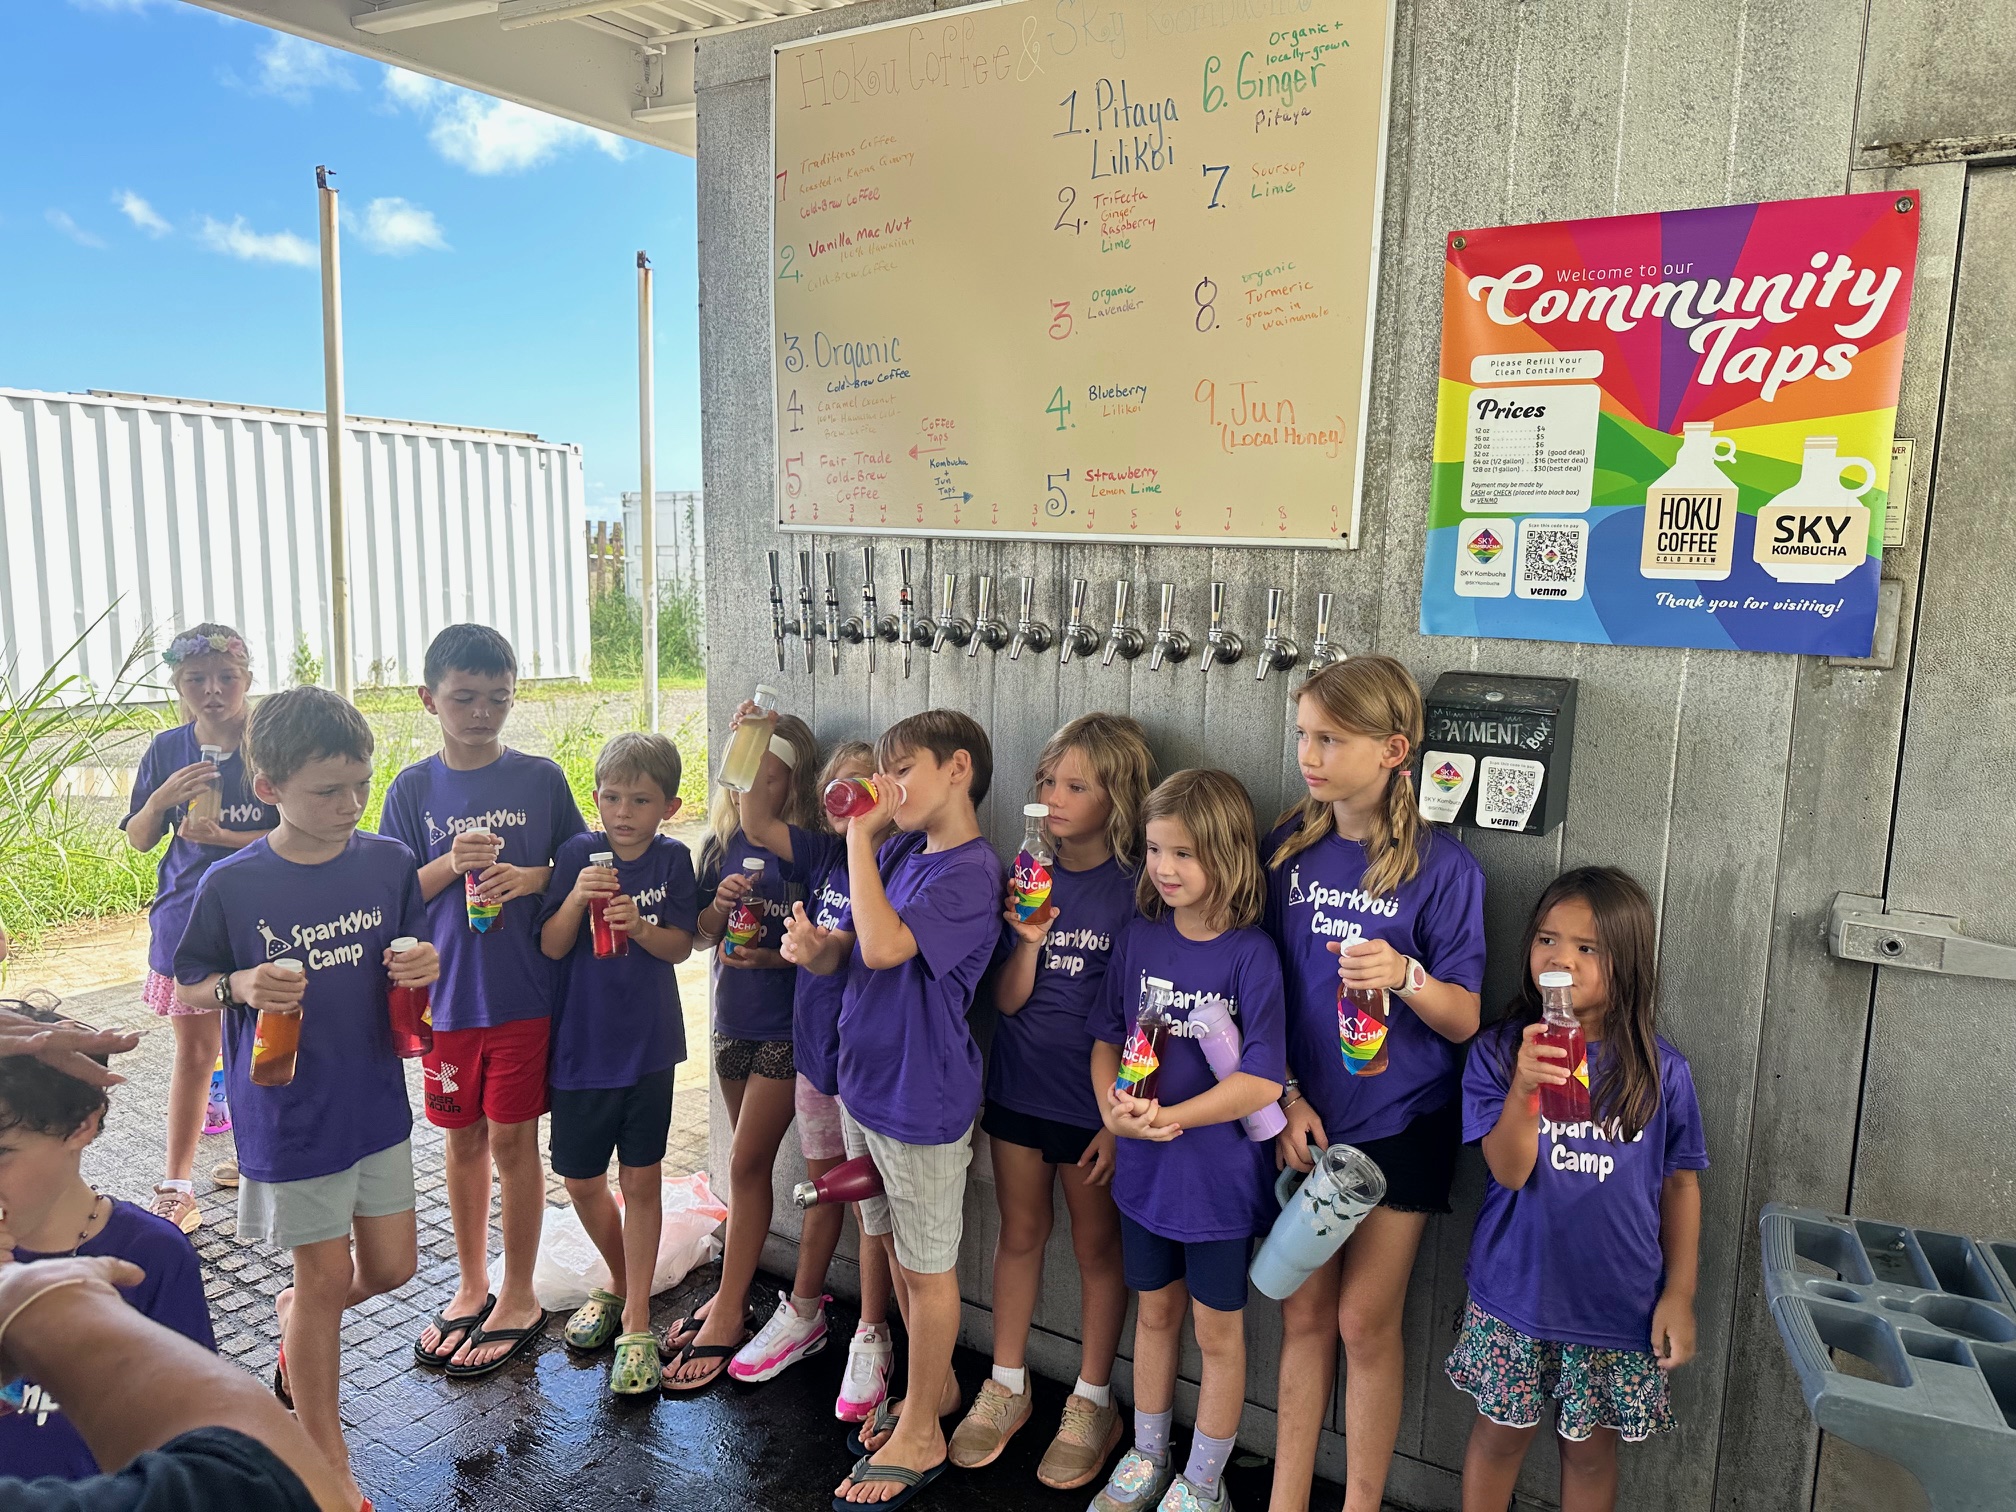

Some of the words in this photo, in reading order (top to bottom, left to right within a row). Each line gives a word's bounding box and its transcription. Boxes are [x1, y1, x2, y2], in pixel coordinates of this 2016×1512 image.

[796, 42, 899, 110] Hoku
[908, 17, 1011, 90] Coffee
[1017, 16, 1045, 82] &
[1236, 51, 1326, 108] Ginger
[1095, 78, 1179, 152] Pitaya
[1091, 136, 1174, 179] Lilikoi
[846, 187, 880, 205] Coffee
[1251, 184, 1295, 199] Lime
[1100, 204, 1136, 225] Ginger
[1100, 216, 1156, 236] Raspberry
[809, 232, 852, 258] Vanilla
[857, 224, 880, 241] Mac
[885, 217, 912, 236] Nut
[1102, 237, 1132, 253] Lime
[1556, 264, 1634, 283] Welcome
[1639, 262, 1658, 278] to
[1663, 260, 1695, 276] our
[1245, 280, 1314, 304] Turmeric
[1467, 250, 1902, 339] Community
[1088, 299, 1144, 320] Lavender
[815, 331, 901, 386] Organic
[1526, 358, 1555, 366] Refill
[1688, 316, 1860, 403] Taps
[877, 369, 910, 382] Coffee
[1525, 366, 1576, 375] Container
[1088, 384, 1147, 404] Blueberry
[1229, 380, 1296, 426] Jun
[1102, 401, 1141, 418] Lilikoi
[1476, 399, 1546, 420] Prices
[921, 417, 955, 432] Coffee
[1537, 425, 1546, 433] $4
[927, 433, 948, 446] Taps
[819, 454, 846, 468] Fair
[854, 451, 892, 465] Trade
[1547, 449, 1567, 457] (good
[1568, 449, 1586, 457] deal)
[929, 458, 968, 469] Kombucha
[1565, 465, 1582, 473] deal)
[826, 472, 888, 485] Cold-Brew
[934, 477, 951, 486] Jun
[1084, 466, 1159, 483] Strawberry
[836, 488, 879, 504] Coffee
[937, 486, 956, 496] Taps
[1091, 485, 1126, 498] Lemon
[1130, 482, 1162, 495] Lime
[1659, 497, 1722, 531] HOKU
[1773, 515, 1851, 543] SKY
[1657, 532, 1718, 553] COFFEE
[1772, 545, 1847, 556] KOMBUCHA
[1530, 587, 1567, 596] venmo
[1656, 592, 1704, 608] Thank
[1707, 598, 1738, 613] you
[1743, 597, 1768, 610] for
[1773, 598, 1844, 618] visiting!
[1437, 719, 1523, 745] PAYMENT
[1526, 722, 1550, 750] BOX
[1491, 818, 1518, 827] venm
[1312, 911, 1362, 938] Camp
[309, 941, 363, 970] Camp
[1551, 1144, 1614, 1183] Camp
